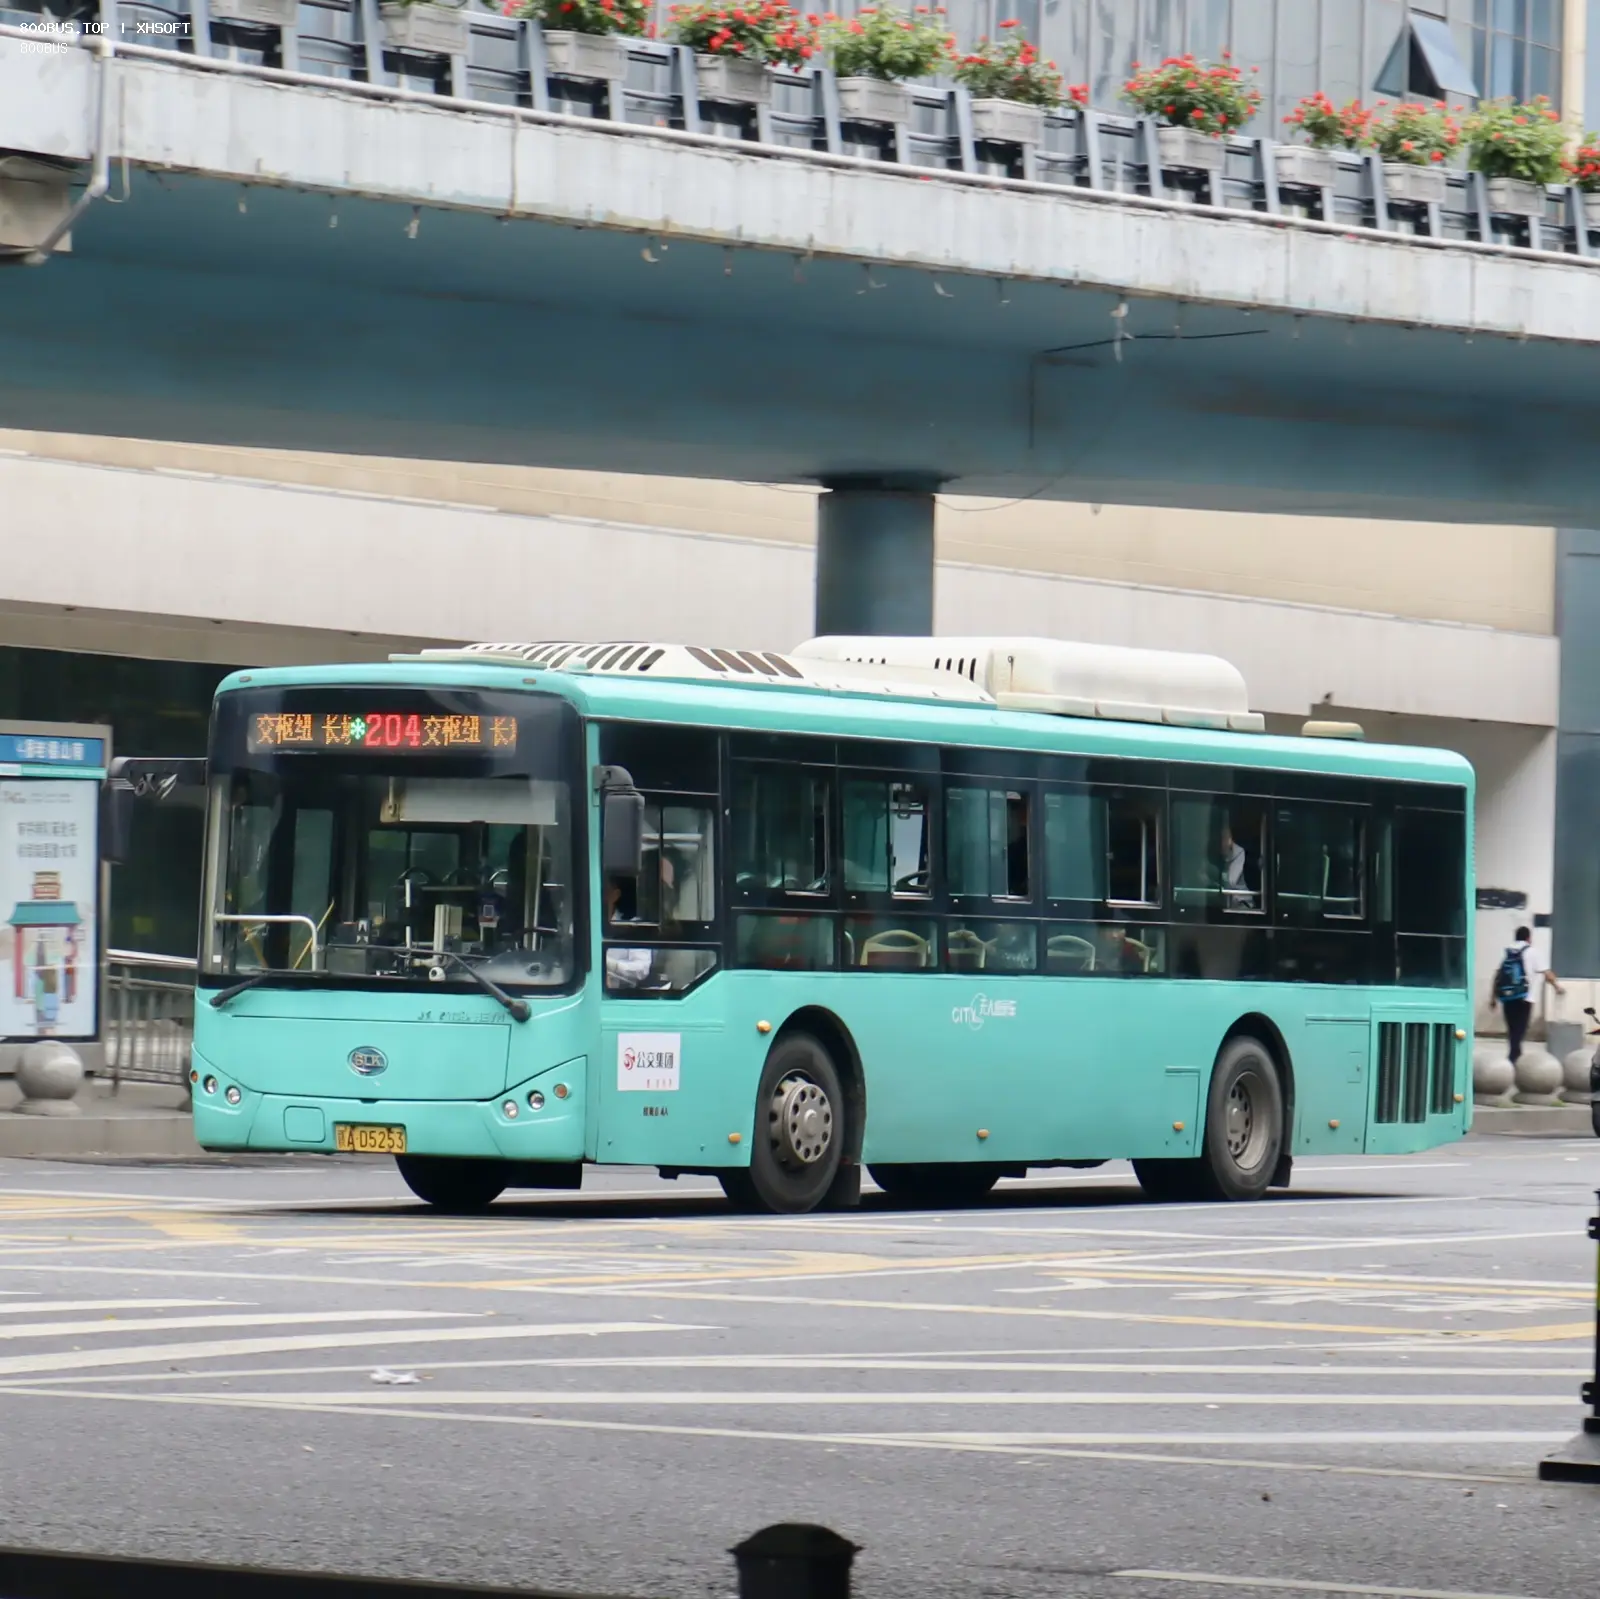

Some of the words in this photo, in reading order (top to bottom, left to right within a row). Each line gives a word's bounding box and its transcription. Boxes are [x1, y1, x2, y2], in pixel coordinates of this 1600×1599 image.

[256, 714, 313, 745] 交枢纽
[365, 715, 420, 746] 204
[422, 715, 481, 746] 交枢纽
[637, 1051, 674, 1069] 公交集团
